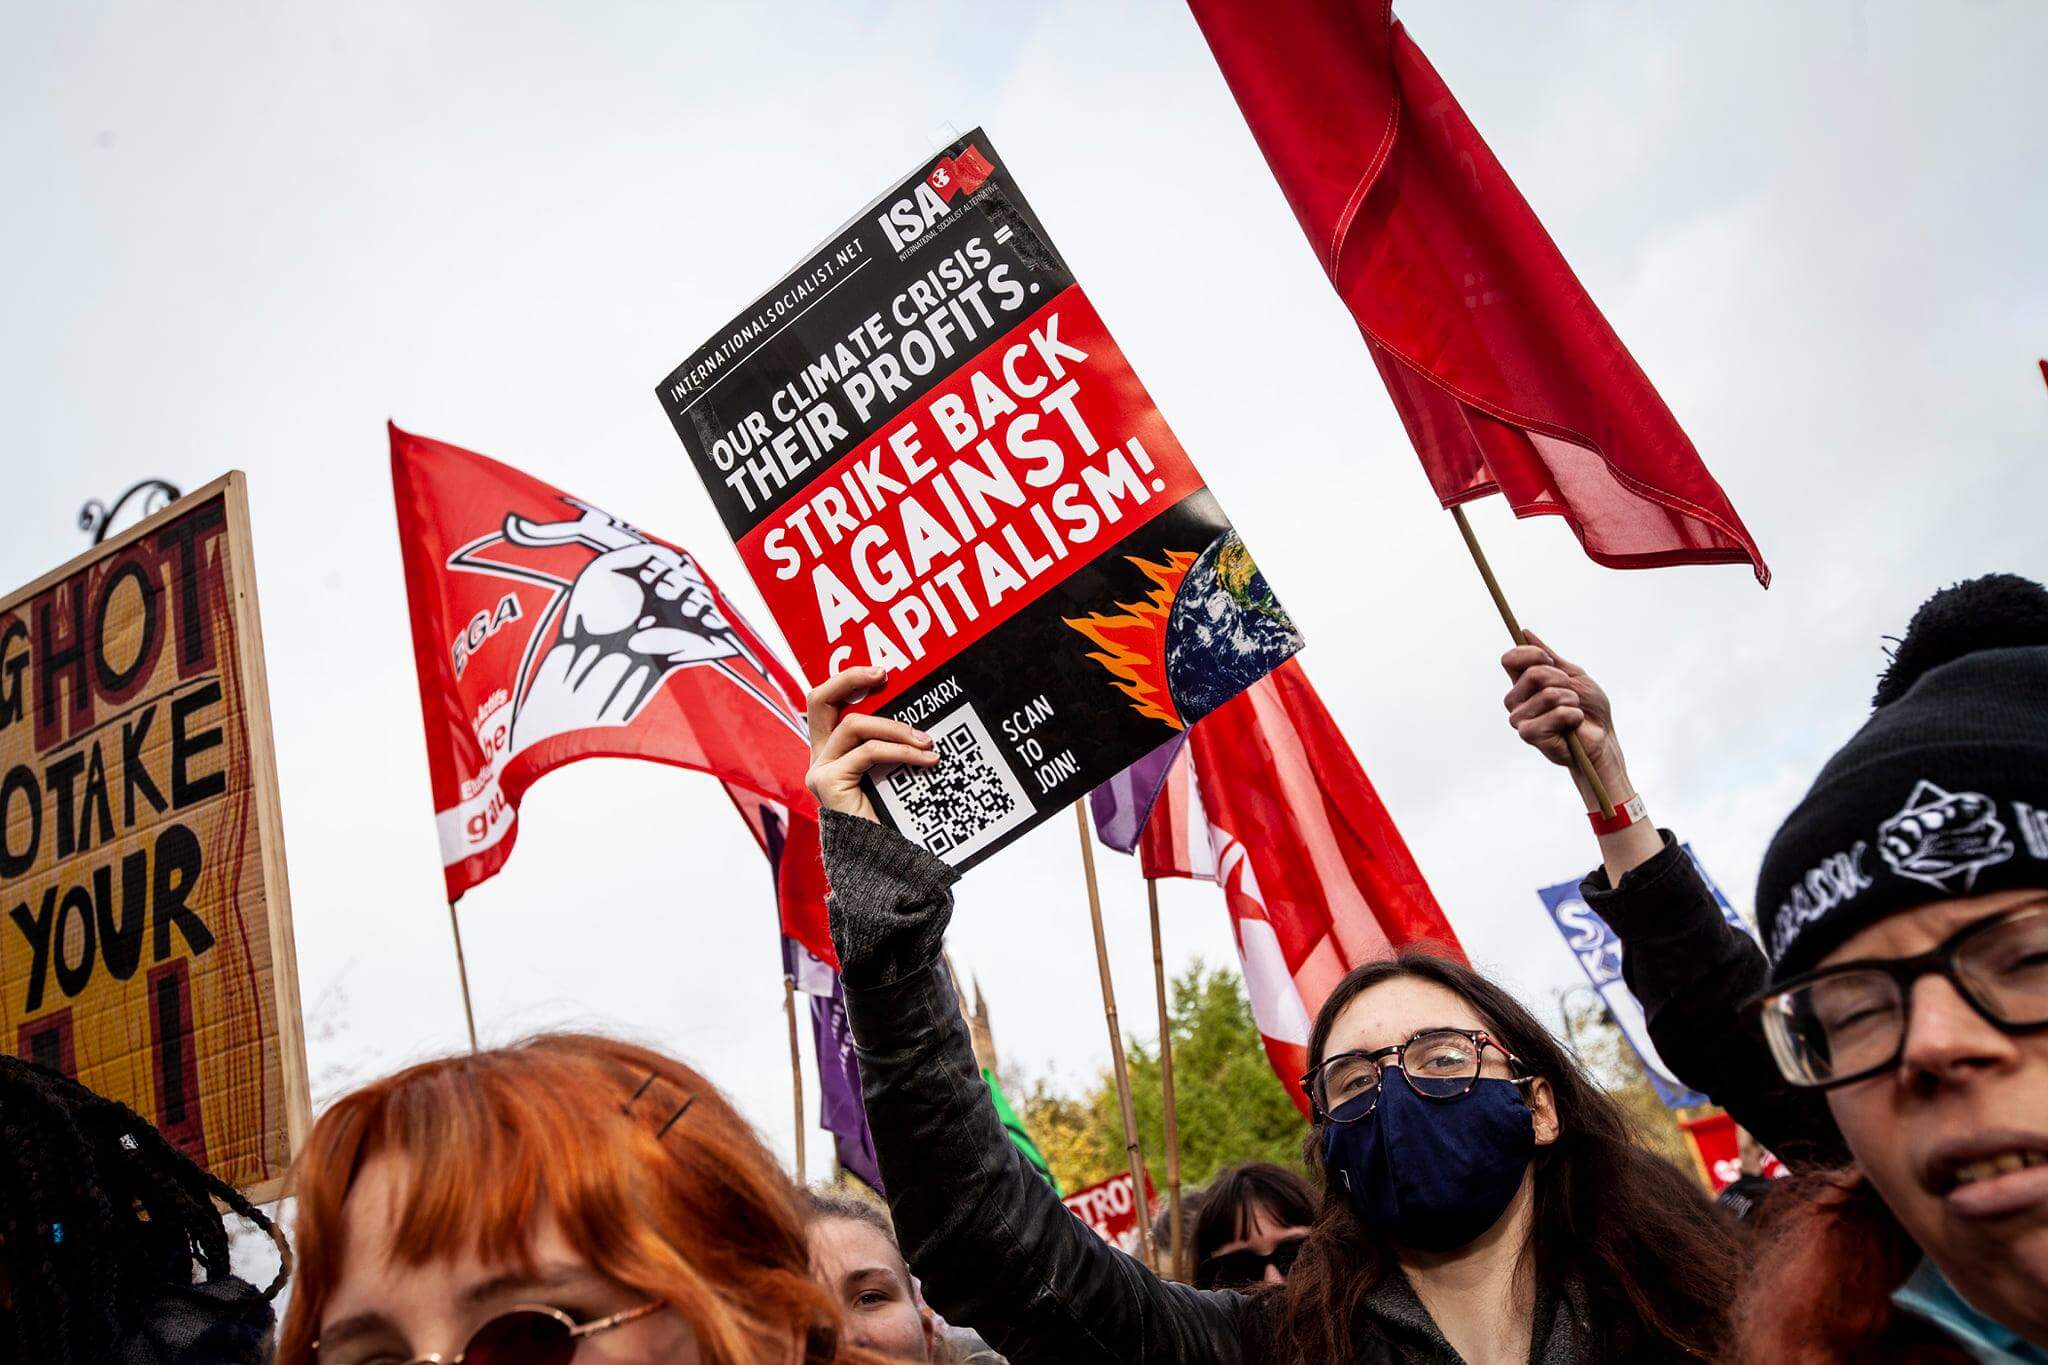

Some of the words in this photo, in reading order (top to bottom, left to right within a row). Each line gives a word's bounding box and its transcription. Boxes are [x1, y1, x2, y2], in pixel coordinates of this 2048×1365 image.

[877, 181, 951, 253] ISA
[899, 230, 938, 262] INTERNATIONAL
[937, 208, 964, 231] SOCIALIST
[963, 182, 1000, 212] ALTERNATIVE
[670, 238, 863, 402] INTERNATIONALSOCIALIST.NET
[712, 411, 774, 471] OUR
[772, 312, 894, 423] CLIMATE
[892, 237, 991, 327] CRISIS
[725, 401, 848, 513] THEIR
[842, 263, 1040, 424] PROFITS.
[763, 422, 938, 581] STRIKE
[929, 313, 1089, 452] BACK
[811, 379, 1100, 644] AGAINST
[45, 681, 226, 860] TAKE
[1002, 694, 1055, 742] SCAN
[1016, 738, 1044, 768] TO
[1034, 749, 1081, 794] JOIN!
[10, 824, 214, 1013] YOUR
